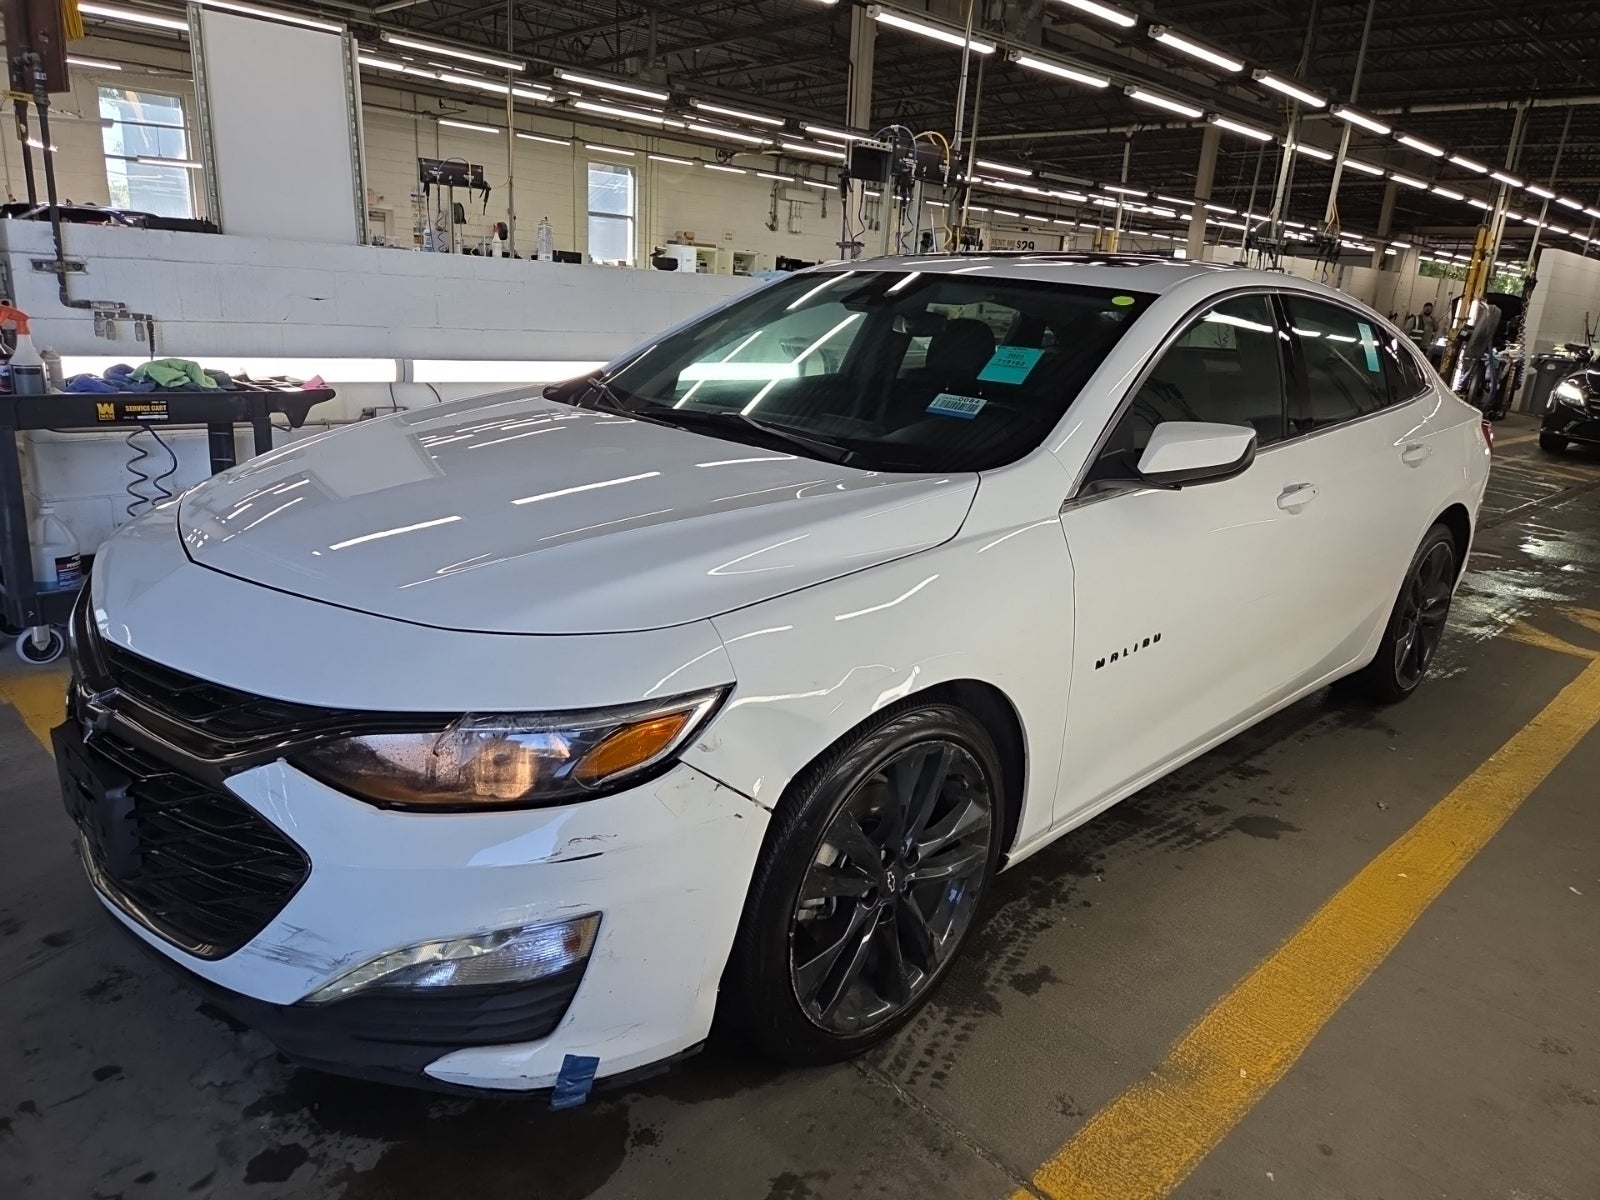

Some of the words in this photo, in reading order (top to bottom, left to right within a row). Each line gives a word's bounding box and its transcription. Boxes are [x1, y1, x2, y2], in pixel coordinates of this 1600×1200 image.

[125, 404, 150, 412] SERVICE
[151, 404, 167, 412] CART
[1094, 632, 1162, 670] MALIBU
